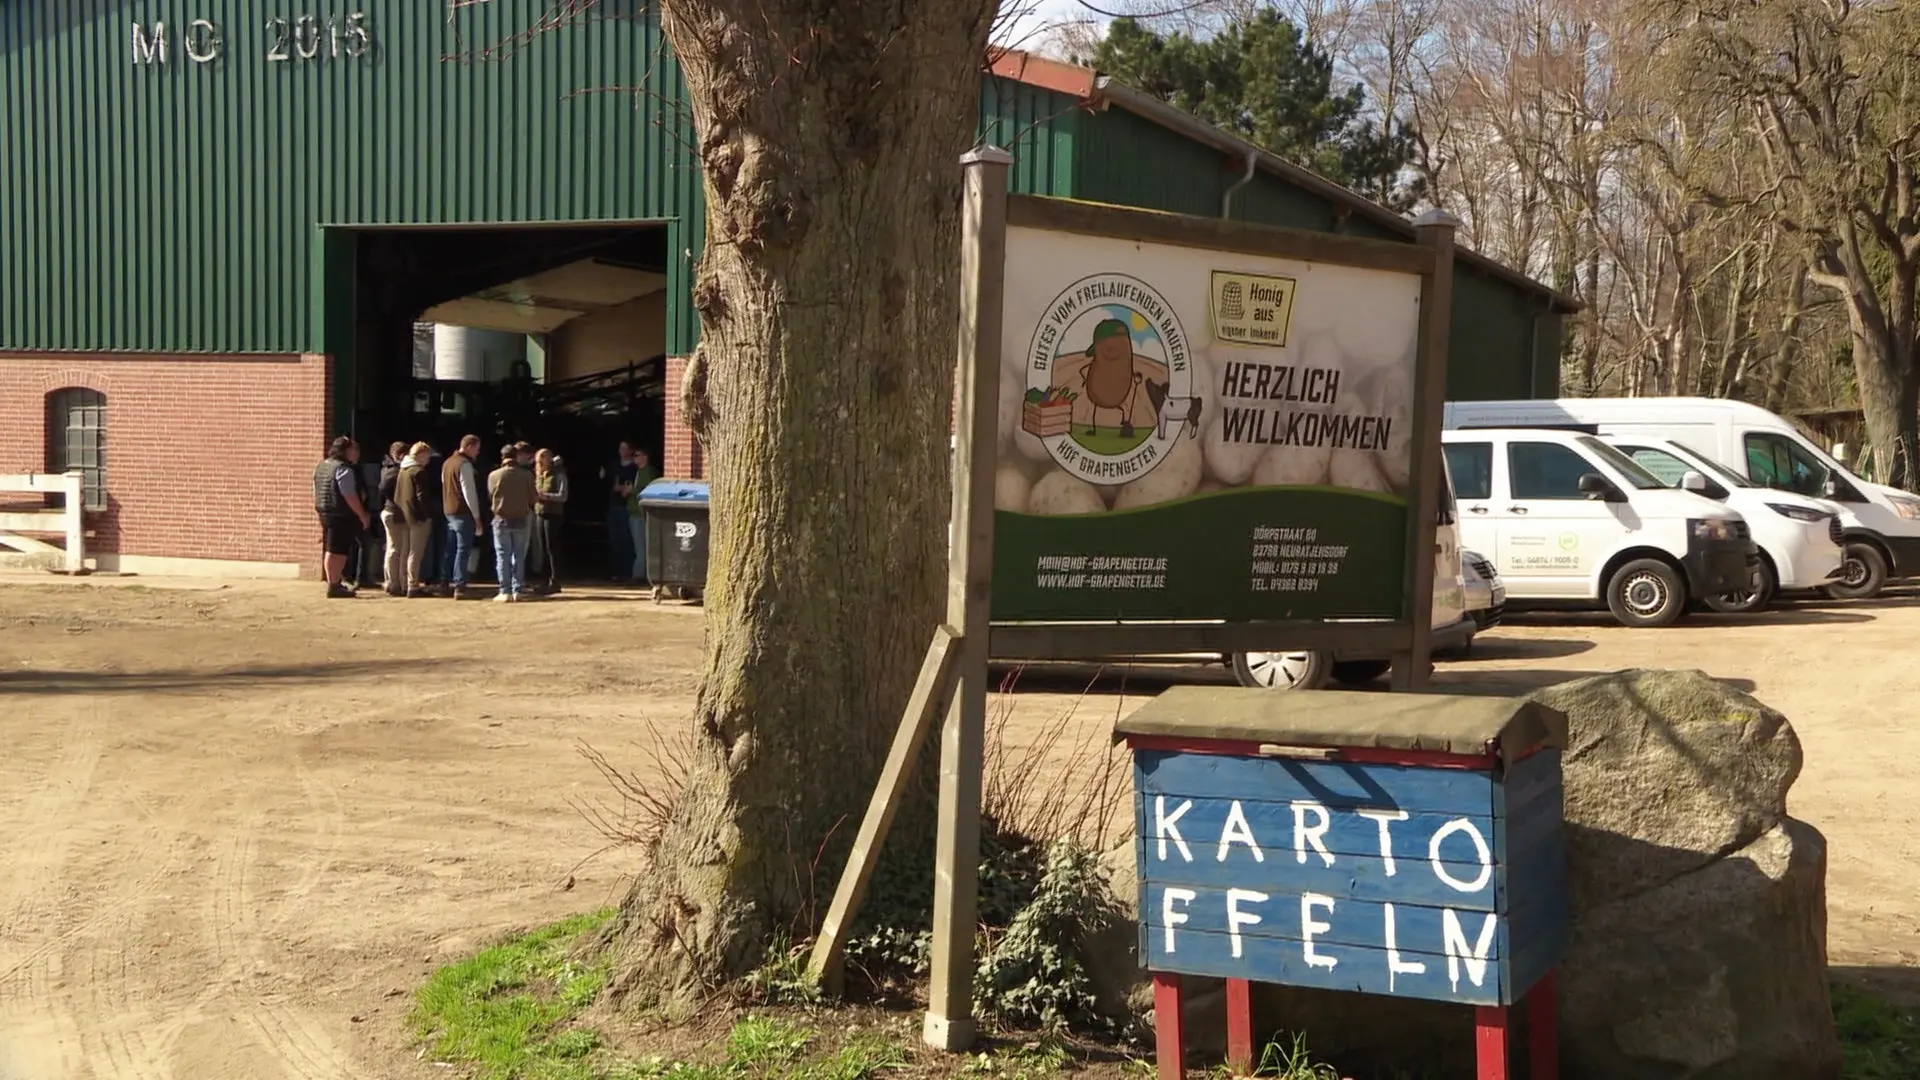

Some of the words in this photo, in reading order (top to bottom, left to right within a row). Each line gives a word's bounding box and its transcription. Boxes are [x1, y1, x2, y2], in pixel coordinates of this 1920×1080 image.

[132, 21, 165, 64] M
[265, 12, 369, 61] 2015
[1250, 282, 1284, 308] Honig
[1254, 308, 1274, 322] aus
[1034, 325, 1057, 371] GUTES
[1052, 298, 1078, 325] VOM
[1076, 282, 1165, 321] FREILAUFENDEN
[1161, 318, 1186, 373] BAUERN
[1222, 361, 1340, 404] HERZLICH
[1222, 406, 1391, 450] WILLKOMMEN
[1057, 439, 1080, 464] HOF
[1079, 445, 1158, 478] GRAPENGETER
[1037, 555, 1168, 571] MOIN@HOF-GRAPENGETER.DE
[1037, 573, 1166, 588] WWW.HOF-GRAPENGETER.DE
[1155, 794, 1492, 893] KARTO
[1162, 887, 1497, 993] FFELN
